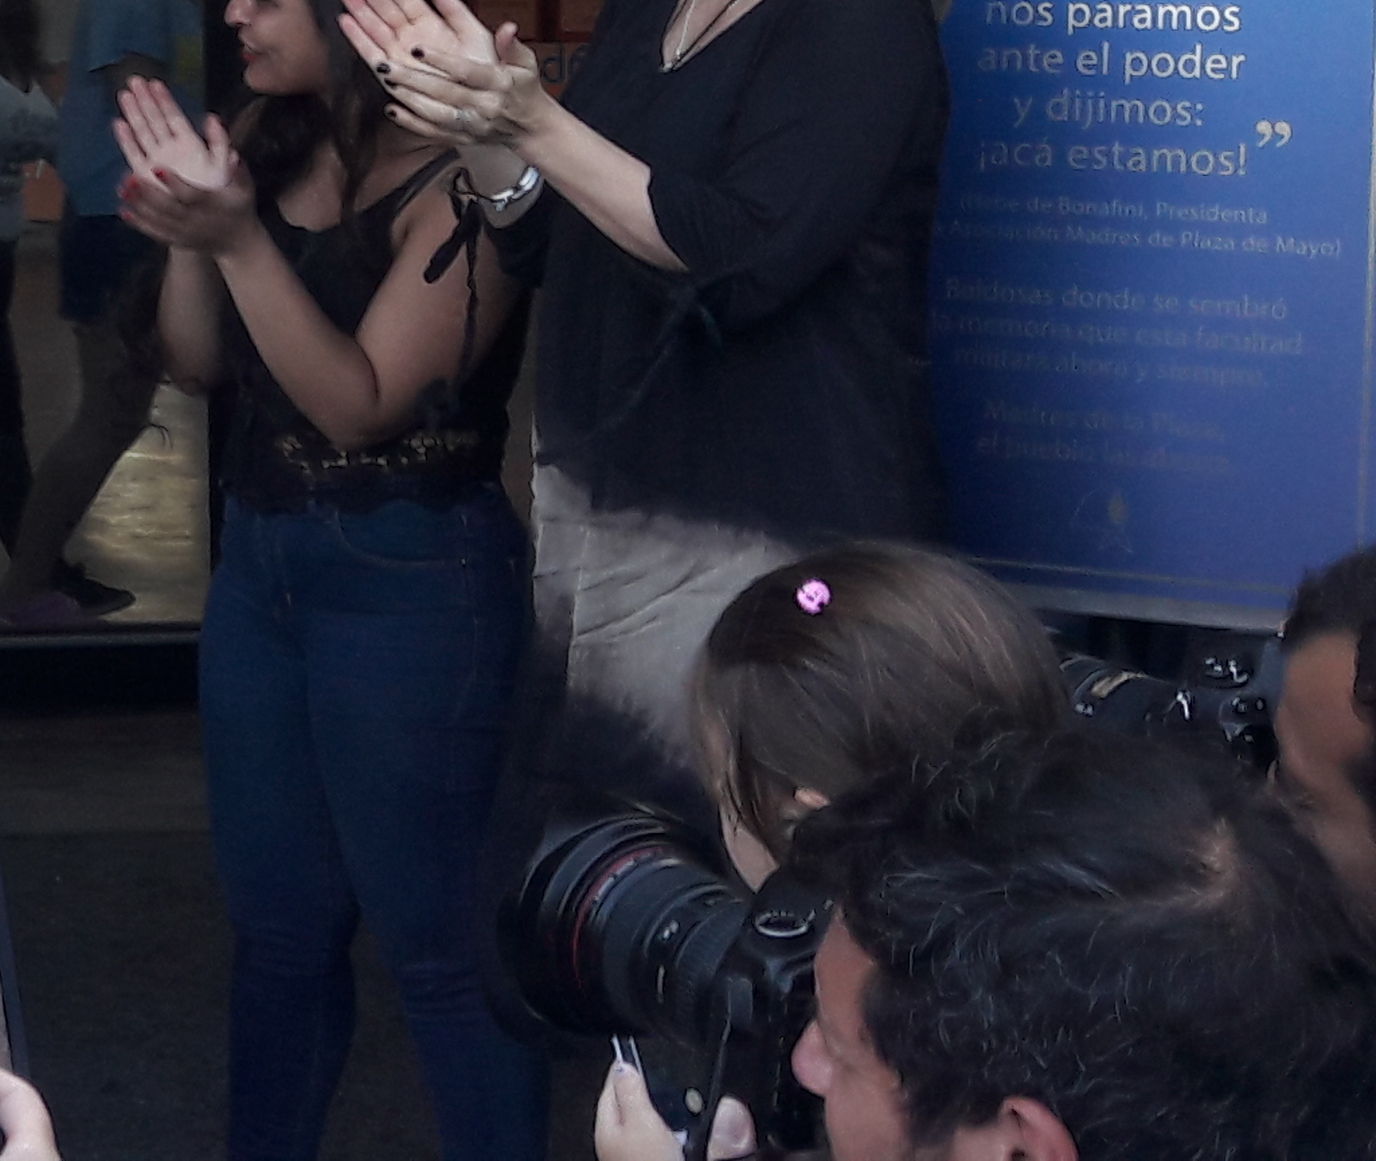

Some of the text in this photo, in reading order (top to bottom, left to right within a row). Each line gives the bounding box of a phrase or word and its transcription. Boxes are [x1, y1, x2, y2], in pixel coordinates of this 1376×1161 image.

[985, 0, 1242, 35] nos paramos
[977, 40, 1247, 85] ante el poder
[1012, 88, 1204, 130] y dijimos:
[1067, 140, 1248, 177] estamos!
[1156, 201, 1268, 224] Presidenta
[1148, 229, 1174, 247] de
[1181, 230, 1235, 251] Plaza
[1242, 236, 1268, 253] de
[1061, 283, 1146, 311] donde
